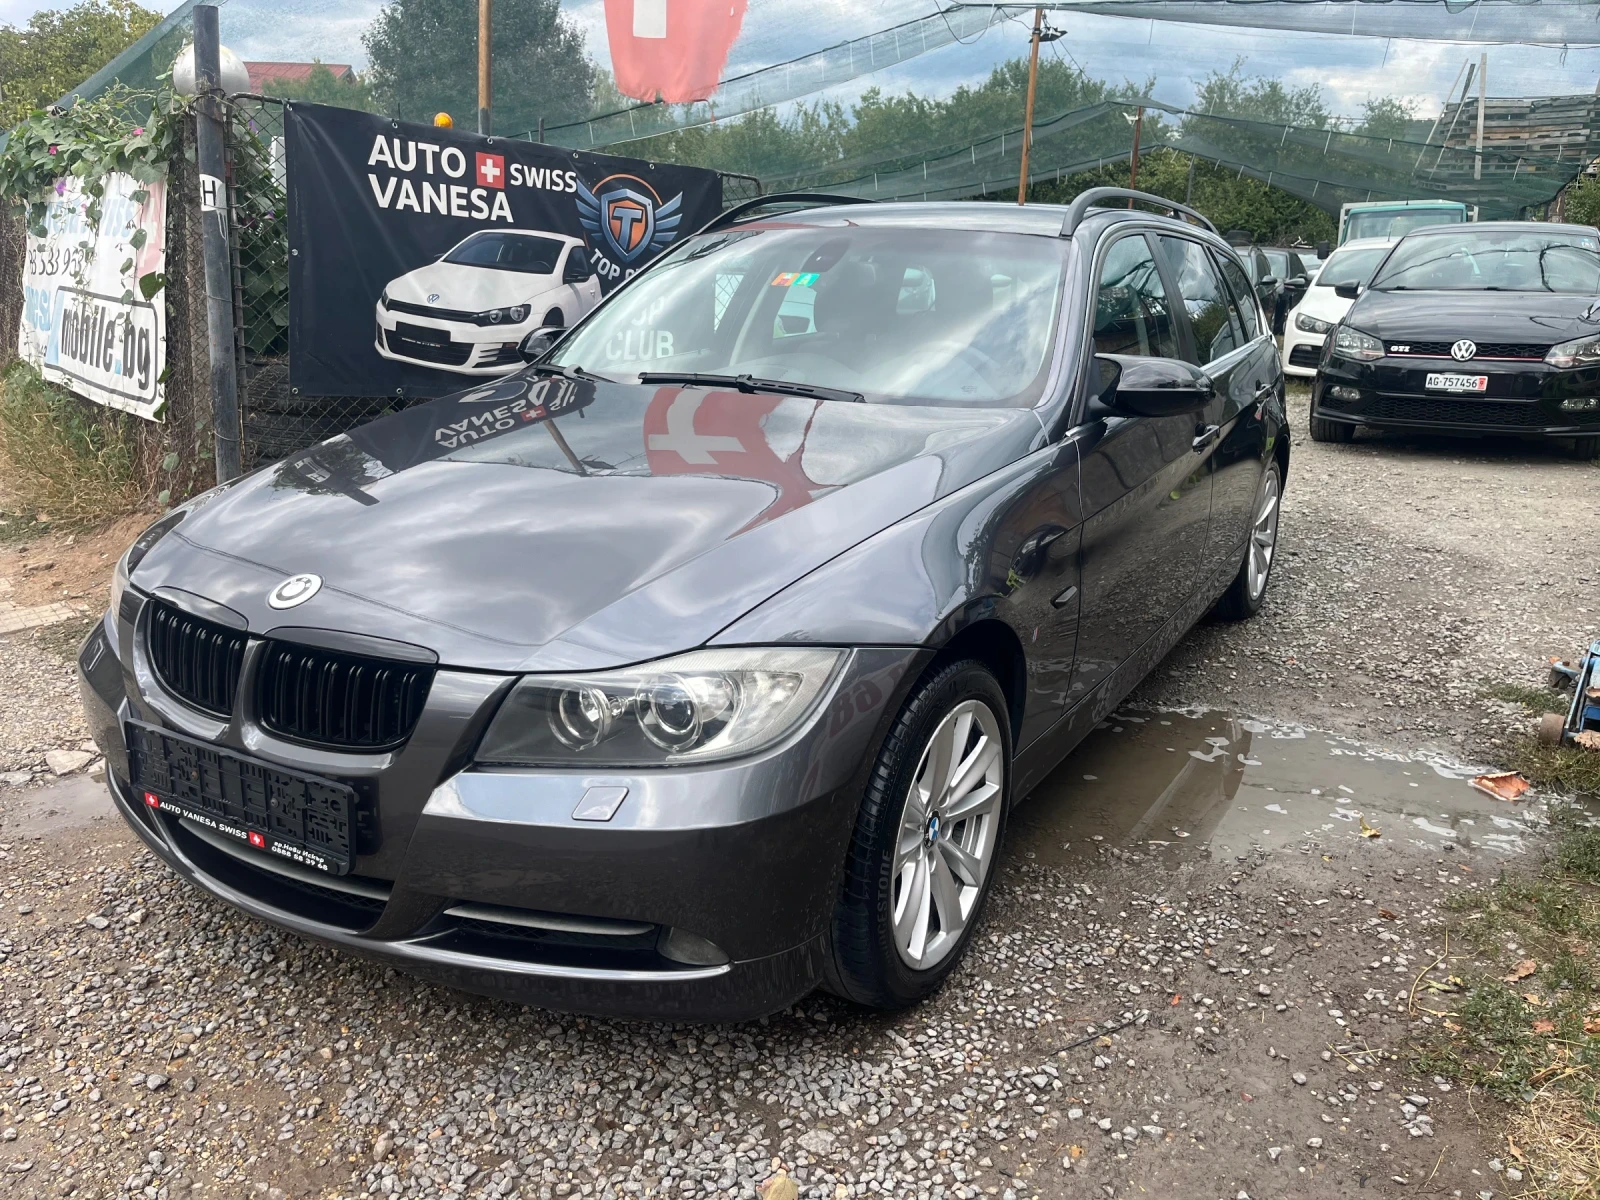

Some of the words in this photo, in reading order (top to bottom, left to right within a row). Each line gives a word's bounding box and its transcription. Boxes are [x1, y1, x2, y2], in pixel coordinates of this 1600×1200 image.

[368, 134, 467, 178] AUTO
[509, 163, 577, 193] SWISS
[368, 173, 514, 223] VANESA
[590, 247, 621, 281] TOP
[61, 301, 151, 391] mobile.bg
[605, 330, 675, 361] CLUB
[159, 801, 181, 814] AUTO
[182, 809, 217, 829] VANESA
[218, 823, 248, 840] SWISS
